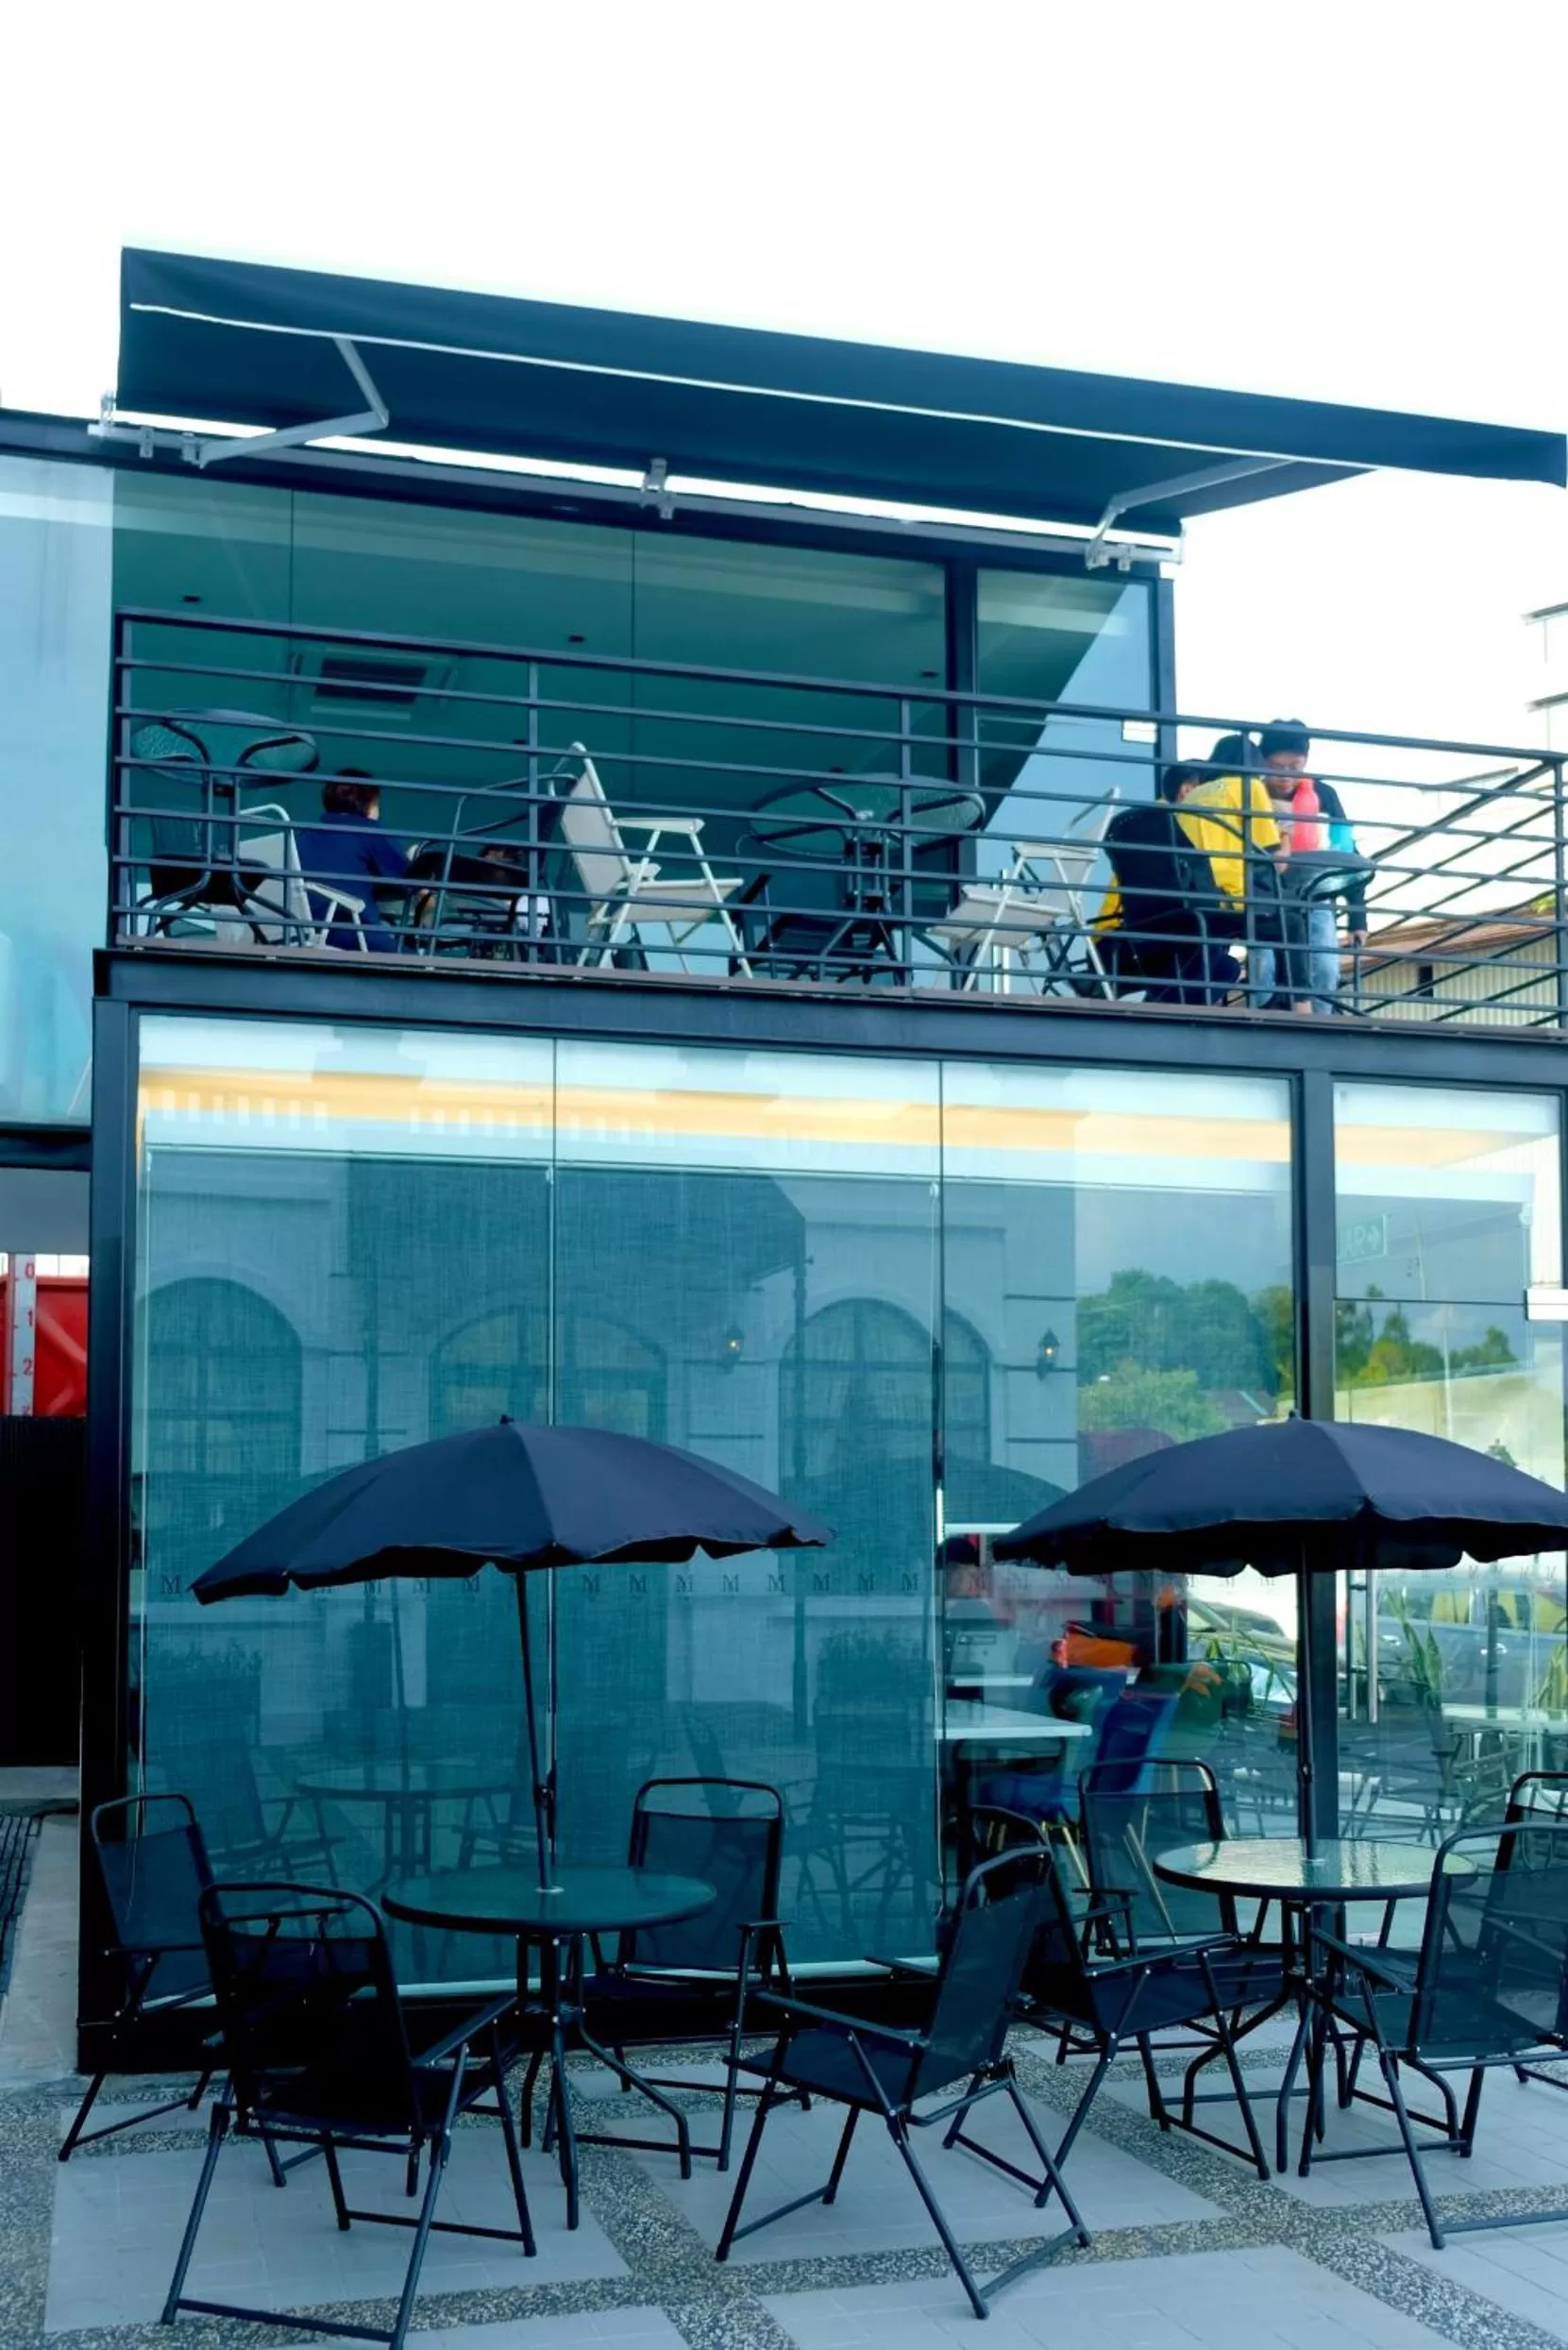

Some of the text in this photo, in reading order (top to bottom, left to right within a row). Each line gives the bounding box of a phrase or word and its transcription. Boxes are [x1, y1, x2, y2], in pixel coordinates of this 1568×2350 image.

[161, 1574, 182, 1594] M
[582, 1572, 919, 1594] M M M M M M M M
